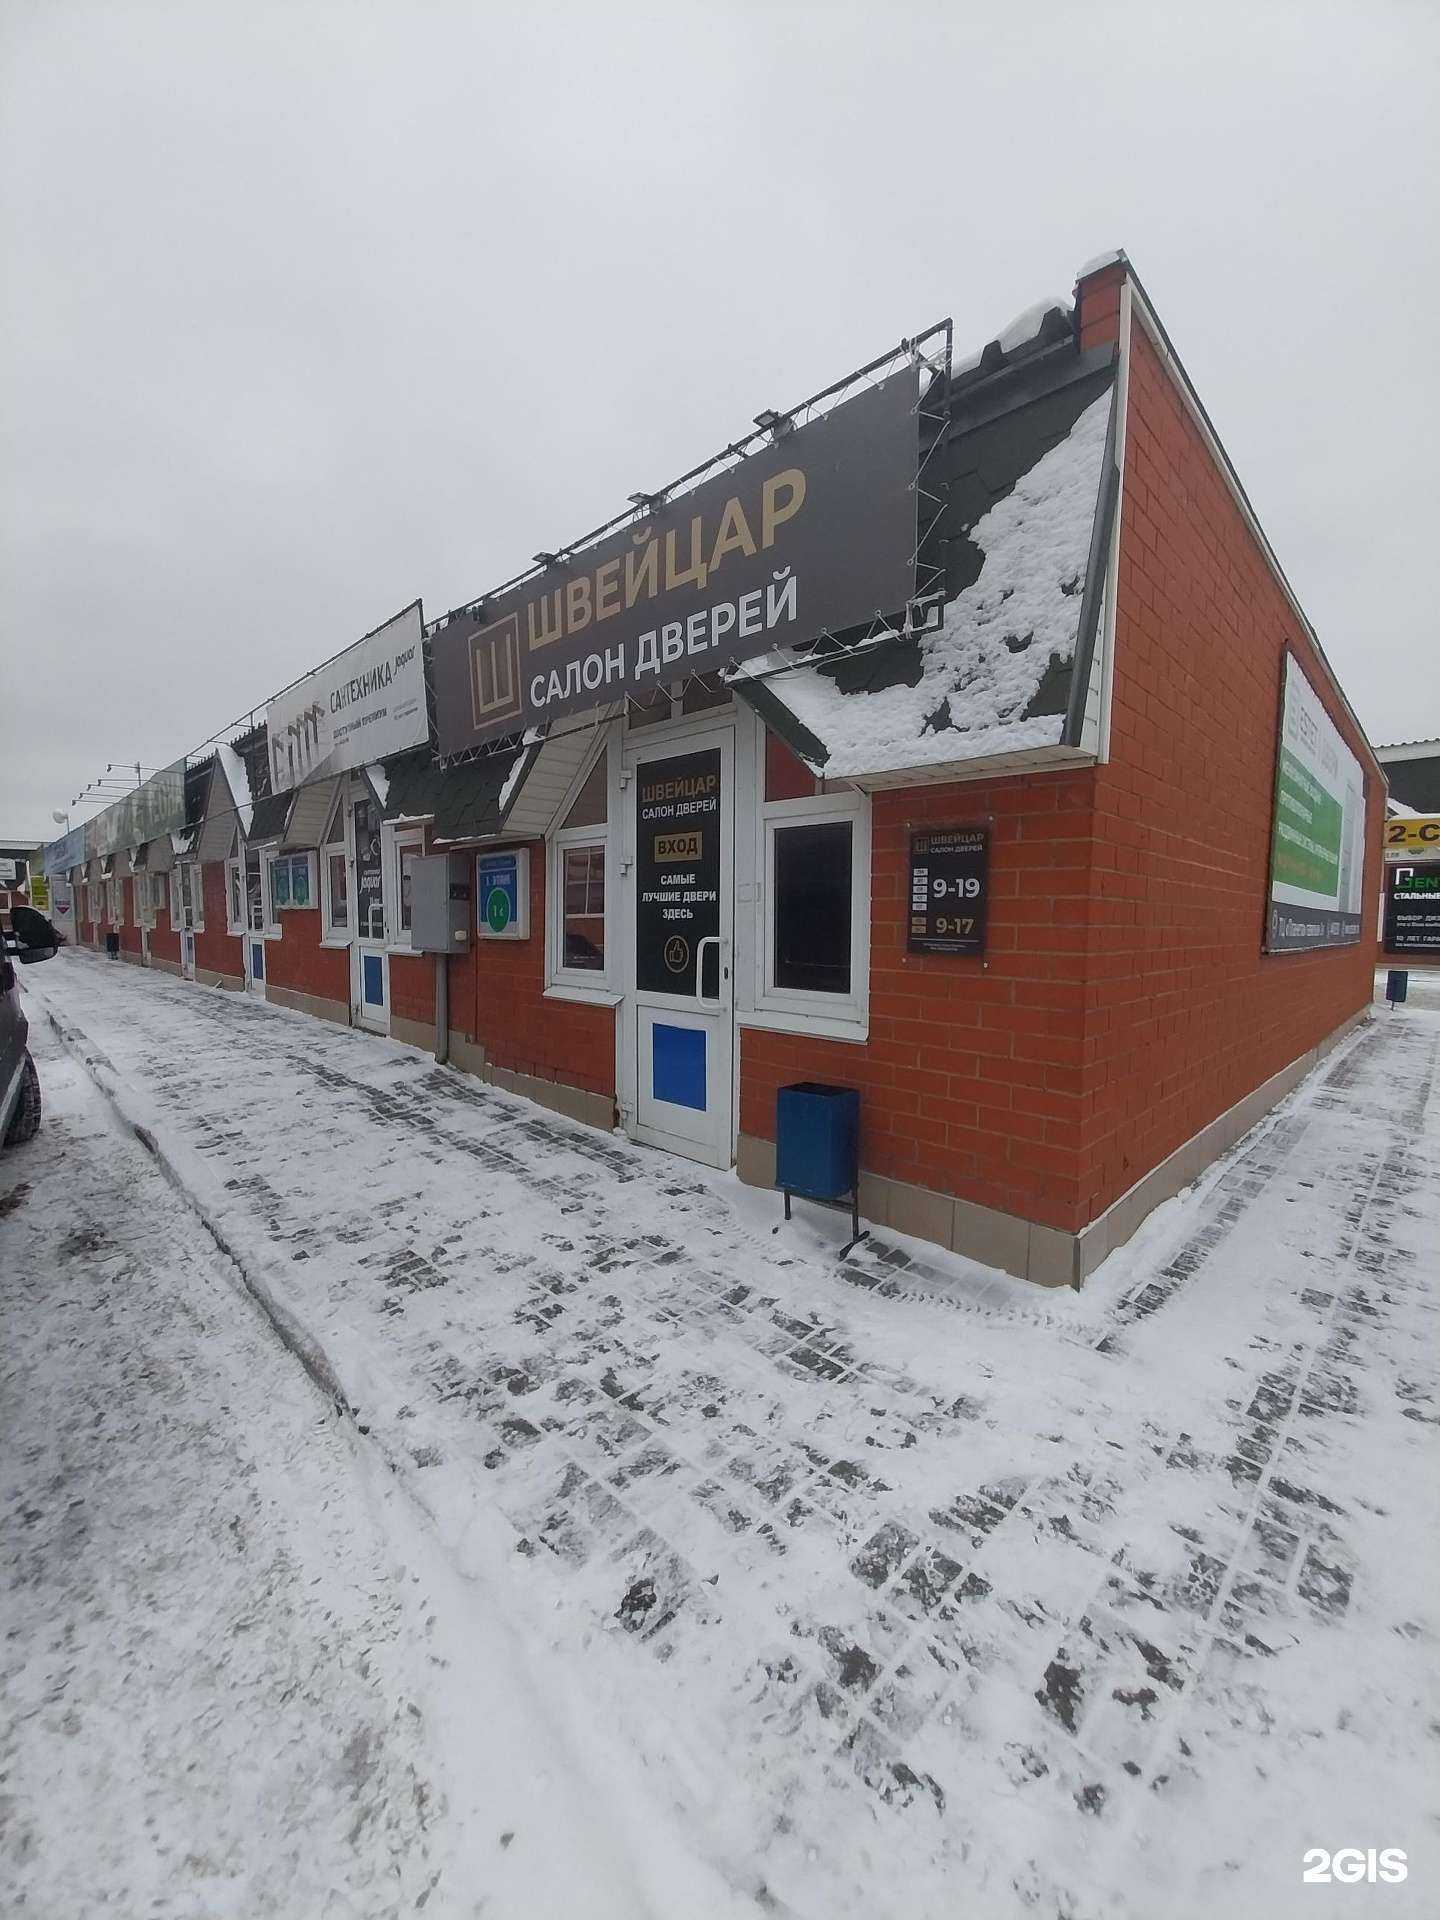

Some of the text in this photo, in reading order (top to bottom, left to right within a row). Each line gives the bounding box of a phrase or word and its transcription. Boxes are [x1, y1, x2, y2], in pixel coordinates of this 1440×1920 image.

[527, 468, 807, 650] ШВЕЙЦАР
[530, 565, 798, 708] САЛОН ДВЕРЕЙ
[330, 661, 393, 714] САНТЕХНИКА
[642, 774, 716, 803] ШВЕЙЦАР
[642, 796, 717, 820] САЛОН ДВЕРЕЙ
[658, 836, 699, 856] ВХОД
[930, 832, 985, 845] ШВЕЙЦАР
[930, 844, 983, 854] САЛОН ДВЕРЕЙ
[661, 873, 696, 886] САМЫЕ
[933, 878, 981, 898] 9-19
[642, 890, 716, 903] ЛУЧШИЕ ДВЕРИ
[1393, 892, 1440, 900] СТАЛЬНЫЕ
[662, 908, 694, 920] ЗДЕСЬ
[936, 917, 974, 934] 9-17
